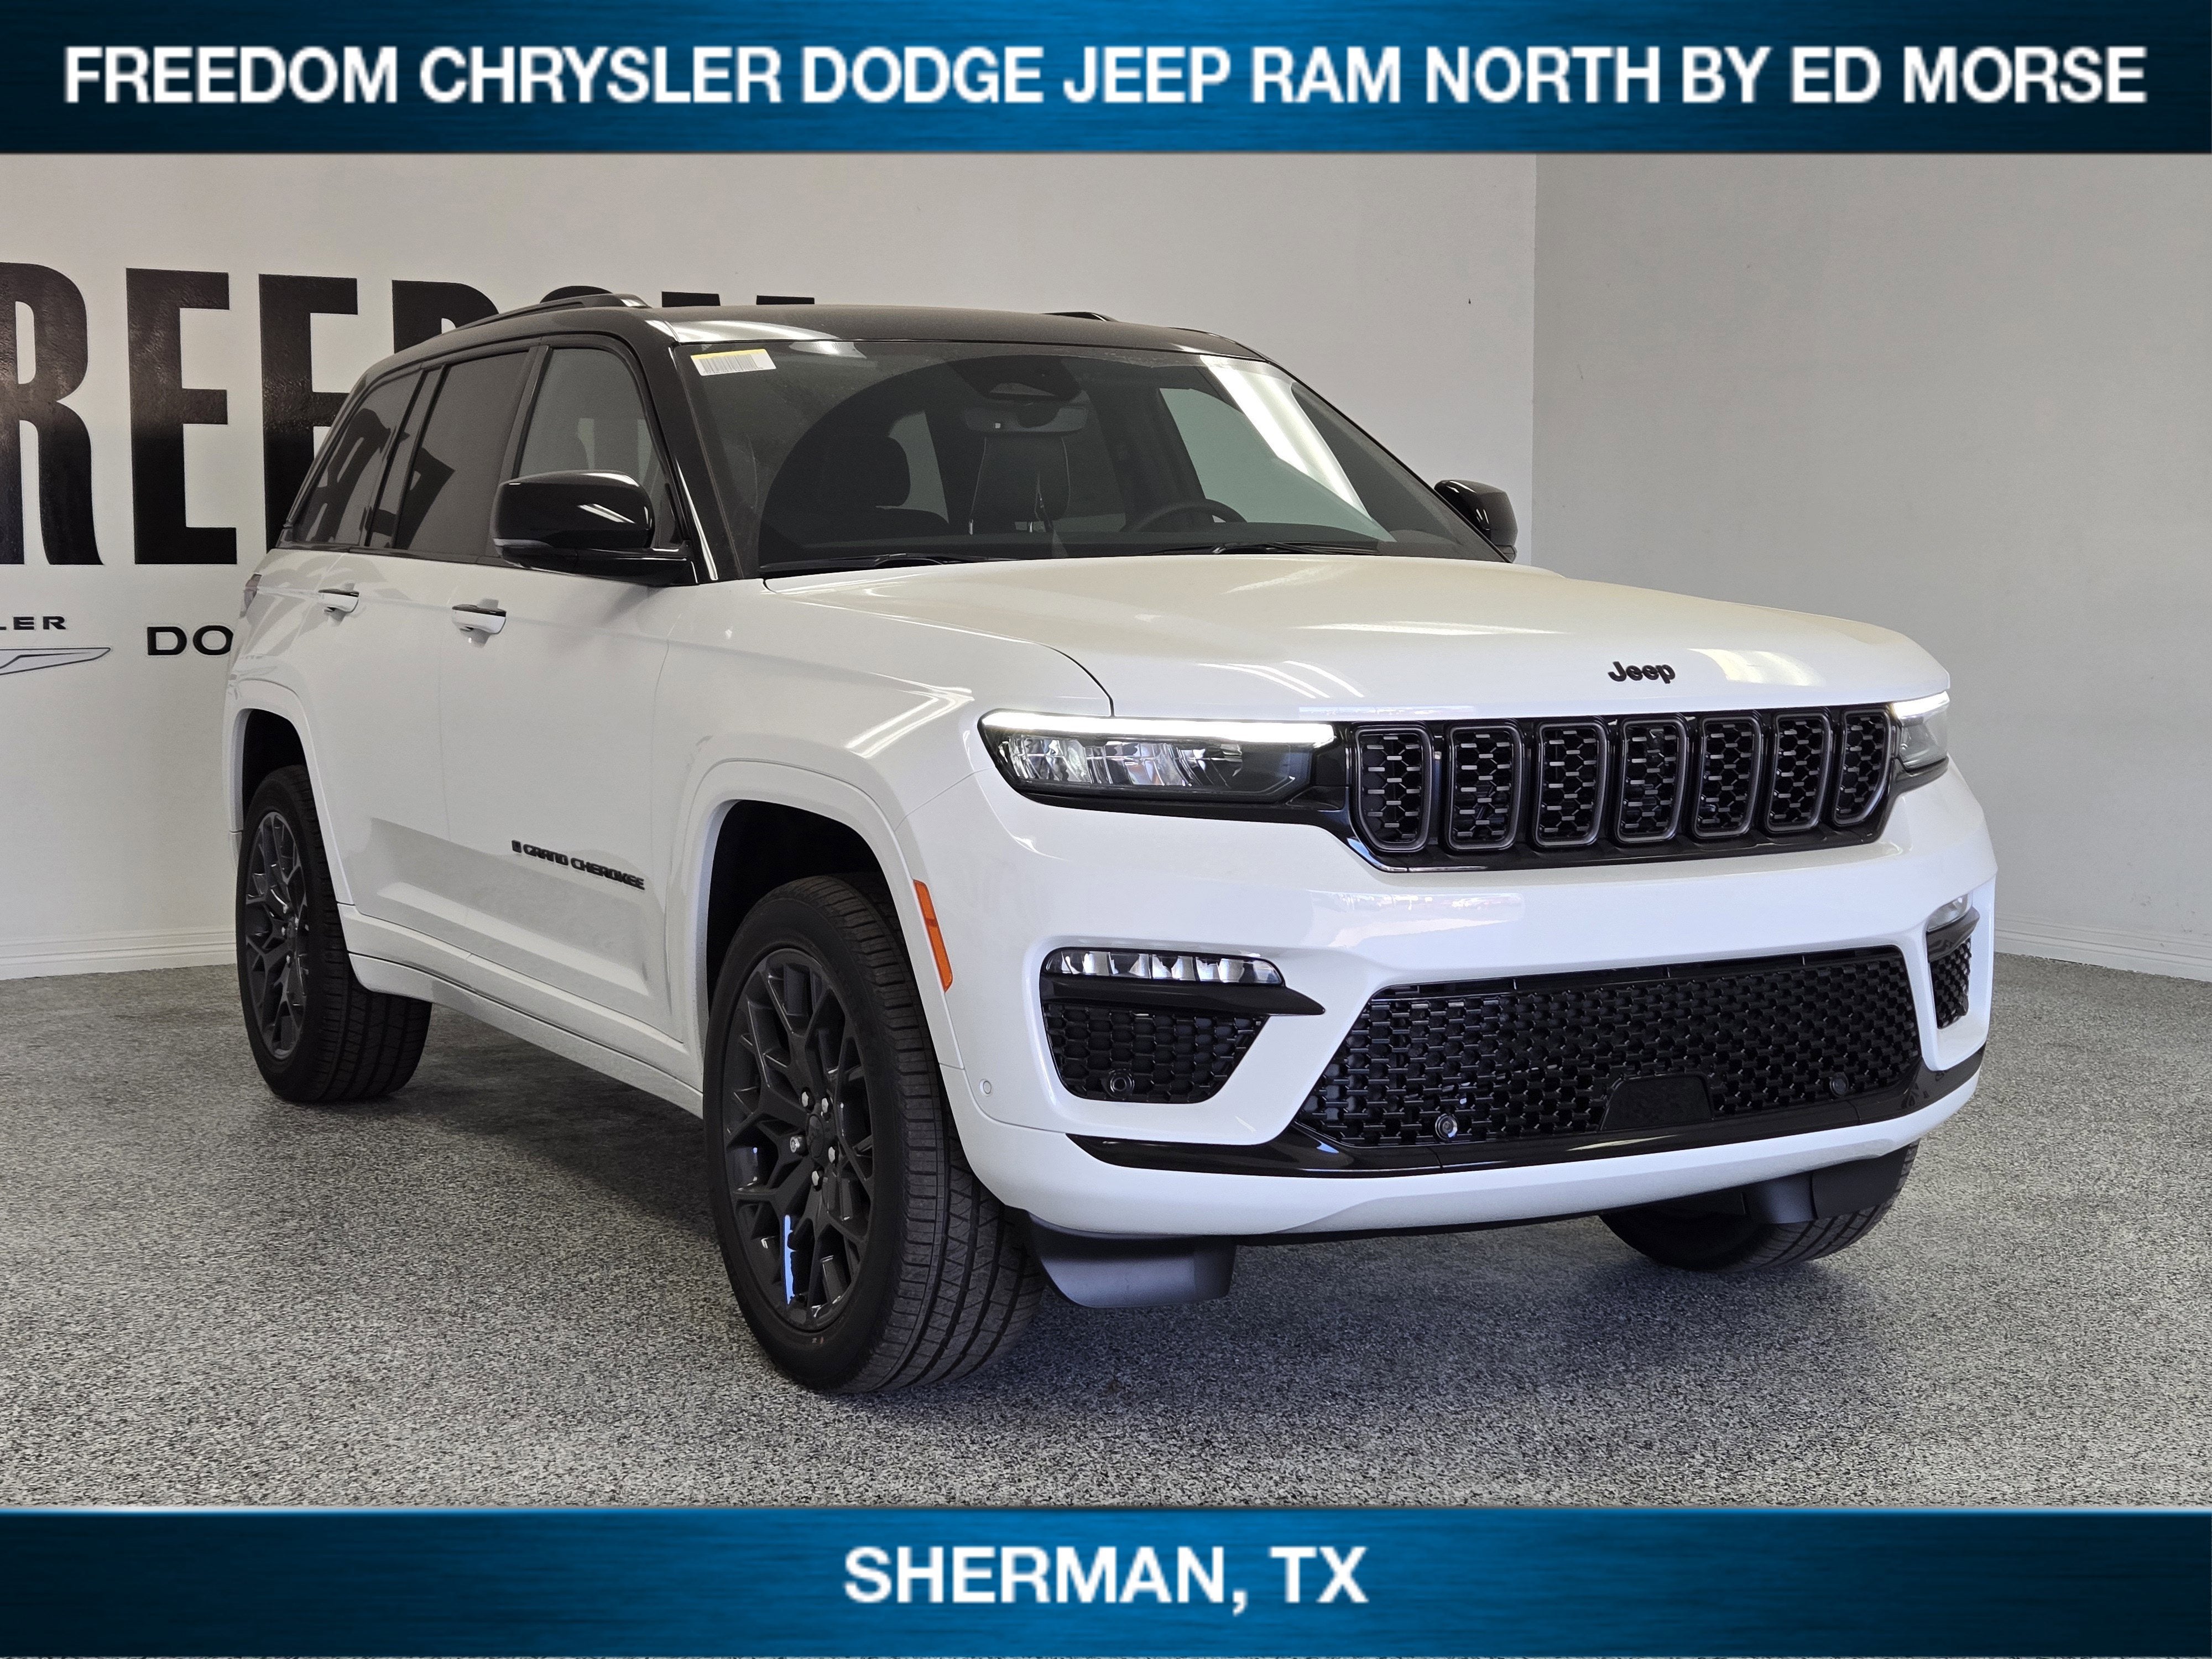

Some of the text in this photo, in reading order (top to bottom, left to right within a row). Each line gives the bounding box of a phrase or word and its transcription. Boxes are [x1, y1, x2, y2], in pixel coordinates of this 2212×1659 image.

[1608, 661, 1676, 684] Jeep
[523, 844, 645, 890] GRAND CHEROKEE
